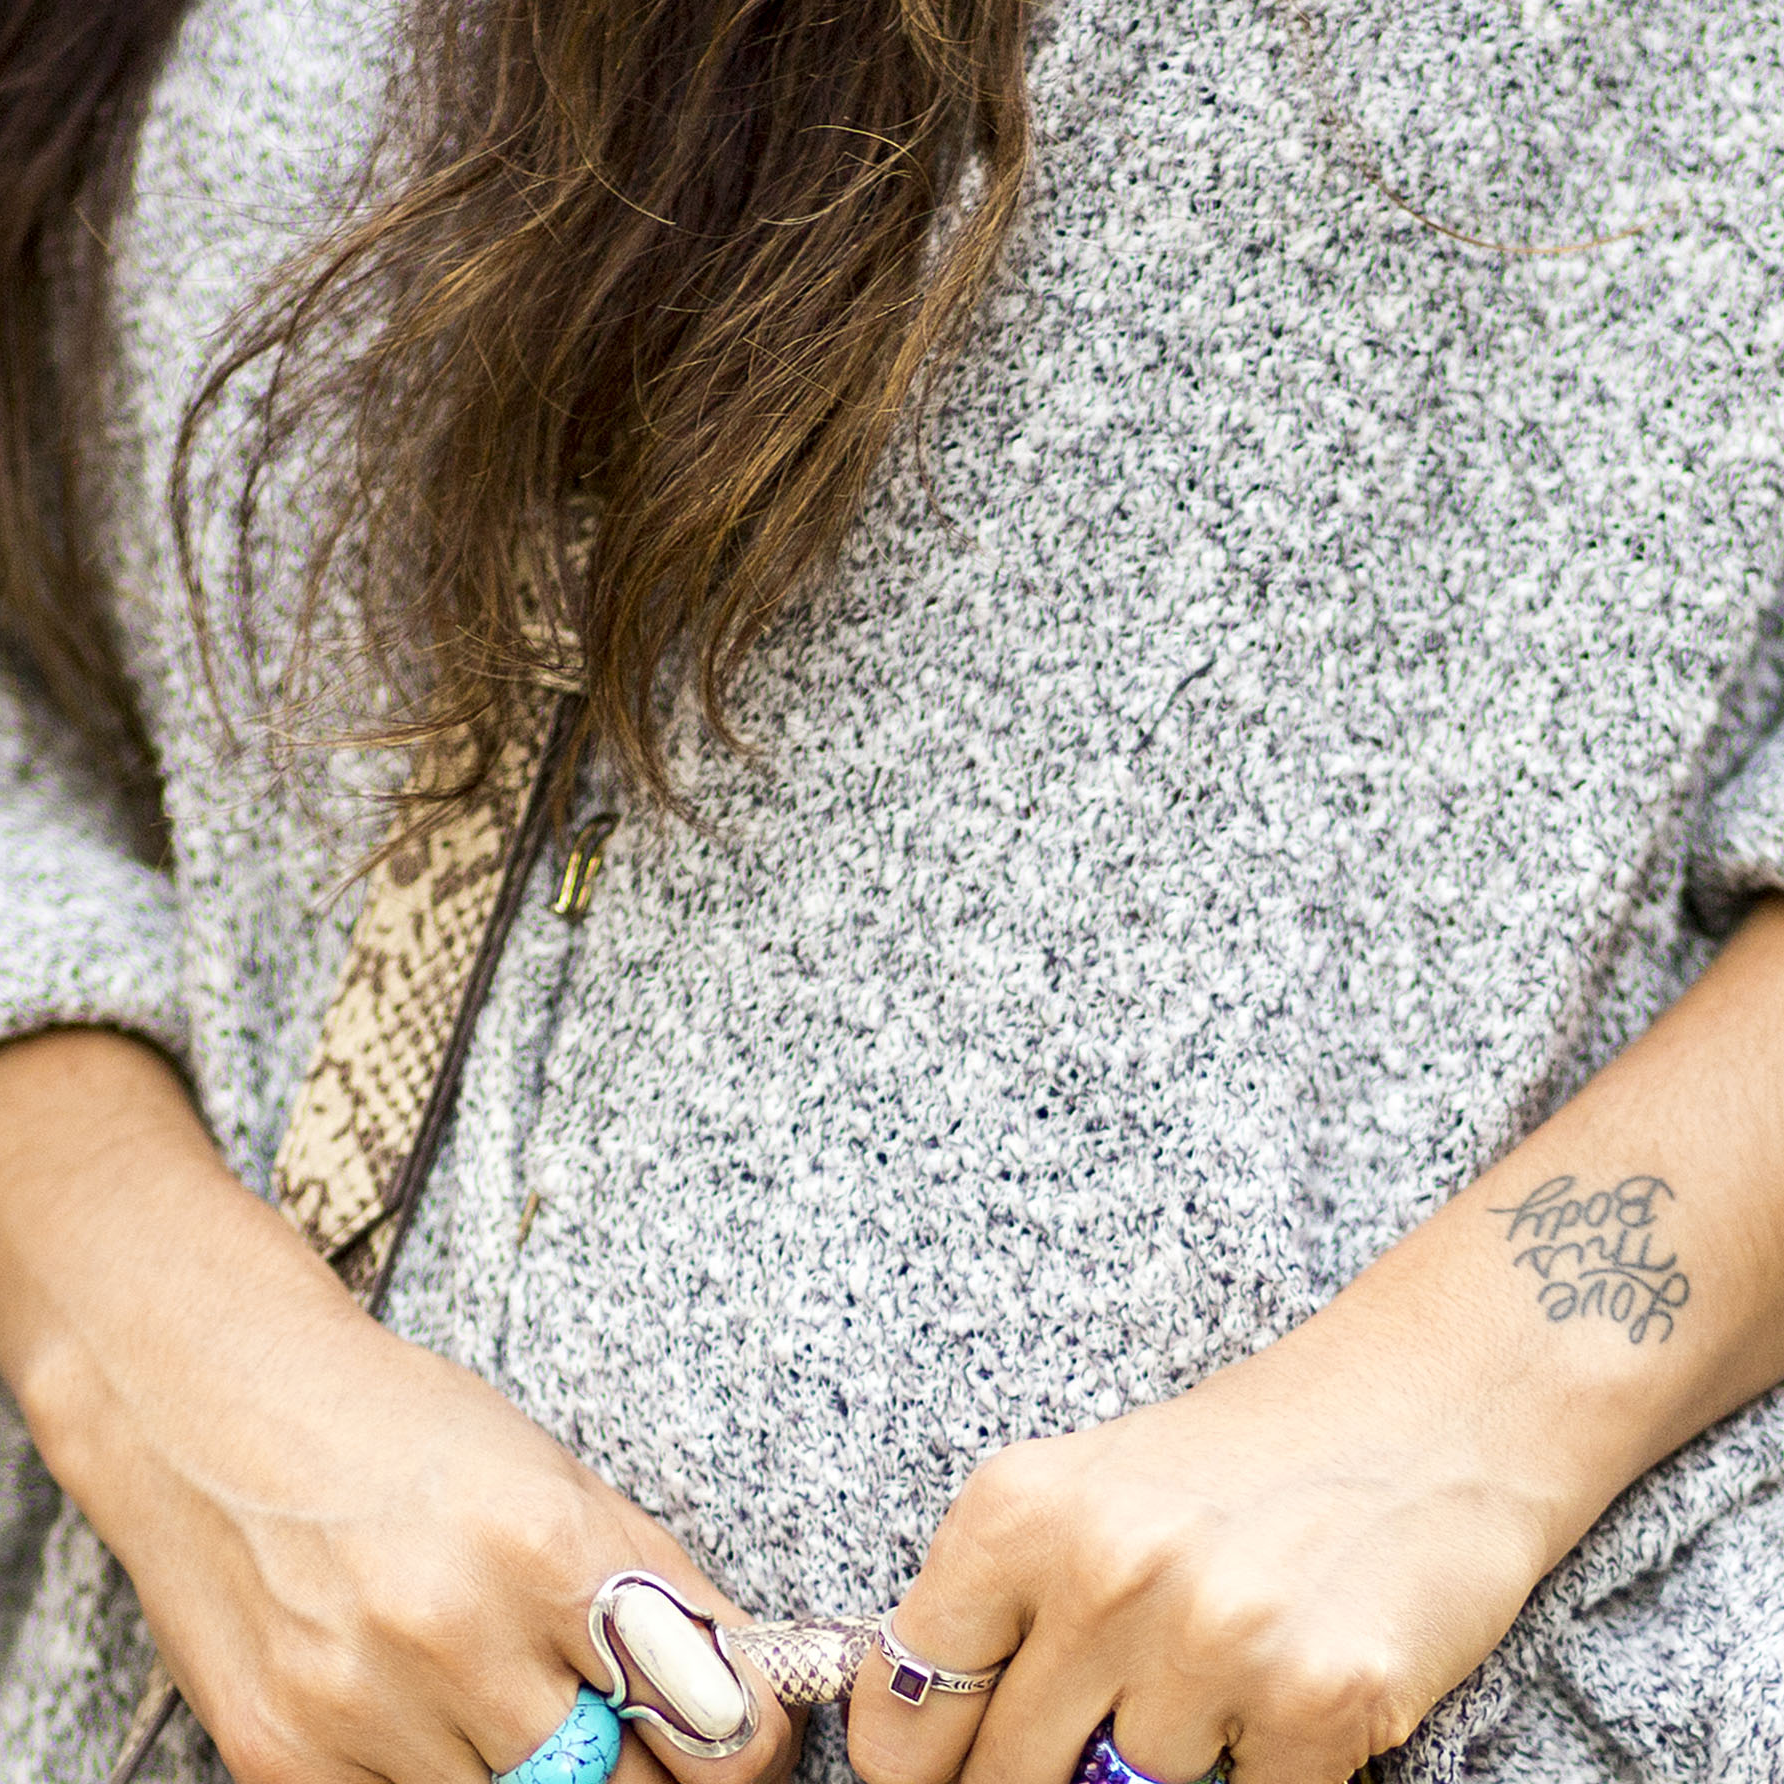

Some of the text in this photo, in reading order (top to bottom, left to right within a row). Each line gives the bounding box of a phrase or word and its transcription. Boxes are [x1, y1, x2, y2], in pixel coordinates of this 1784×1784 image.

[1487, 1175, 1675, 1241] Body
[1513, 1230, 1677, 1279] This
[1537, 1268, 1690, 1345] Love
